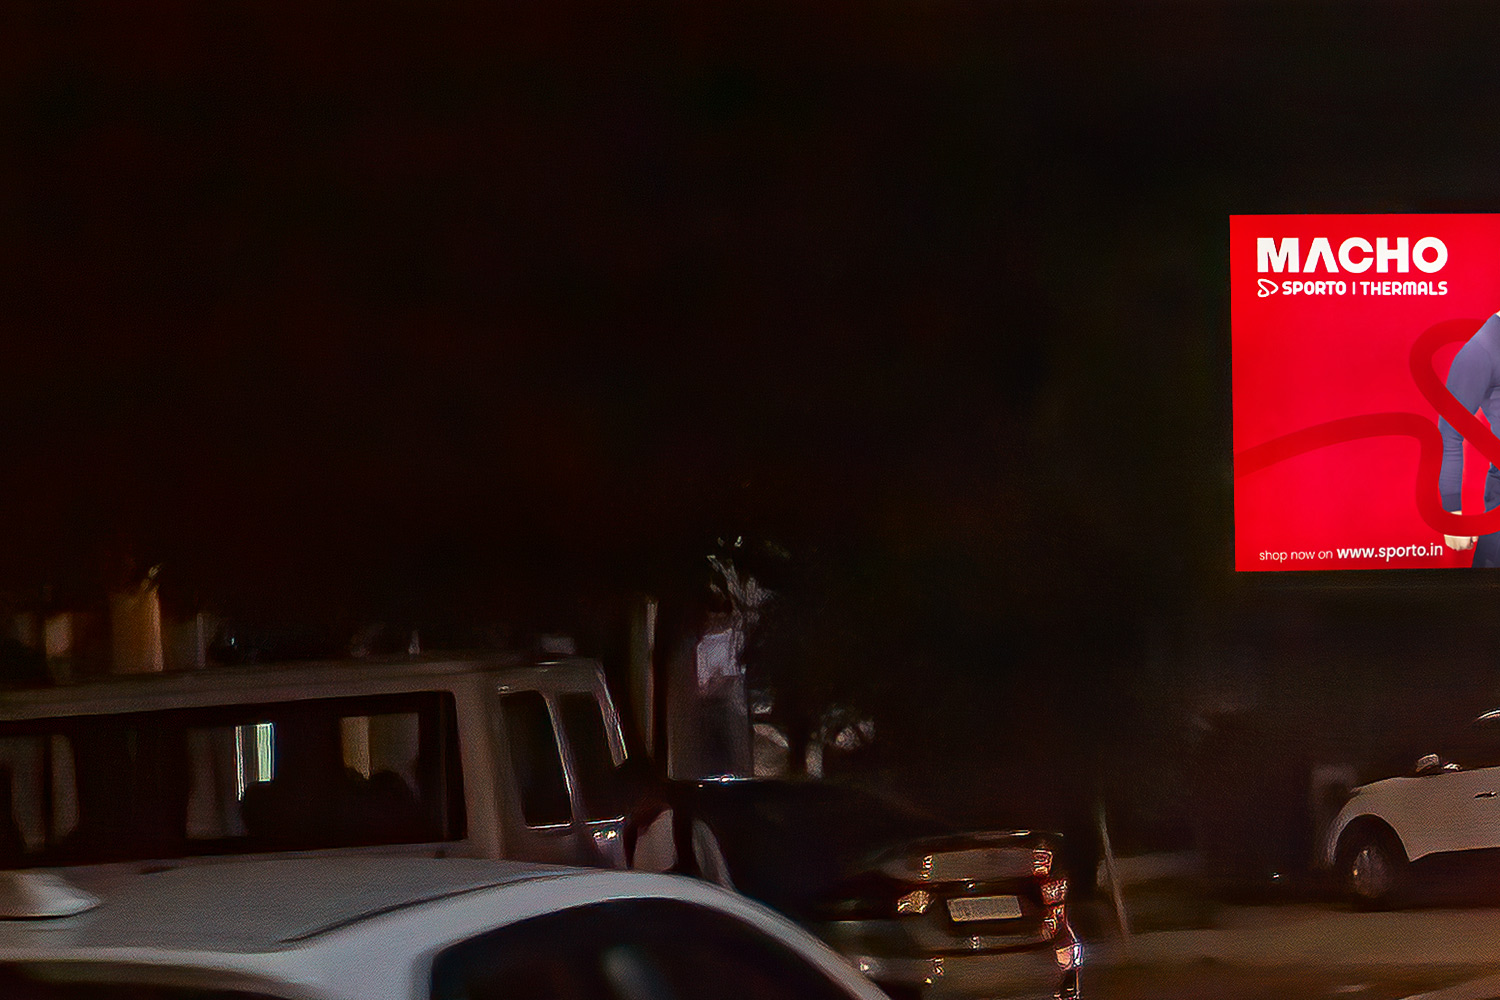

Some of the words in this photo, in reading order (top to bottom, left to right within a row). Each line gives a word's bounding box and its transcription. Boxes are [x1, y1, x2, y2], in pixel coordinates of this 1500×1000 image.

[1257, 236, 1448, 273] MACHO
[1281, 281, 1347, 296] SPORTO
[1360, 281, 1448, 296] THERMALS
[1259, 551, 1288, 563] shop
[1290, 550, 1316, 560] now
[1317, 549, 1334, 559] on
[1336, 543, 1443, 562] www.sporto.in
